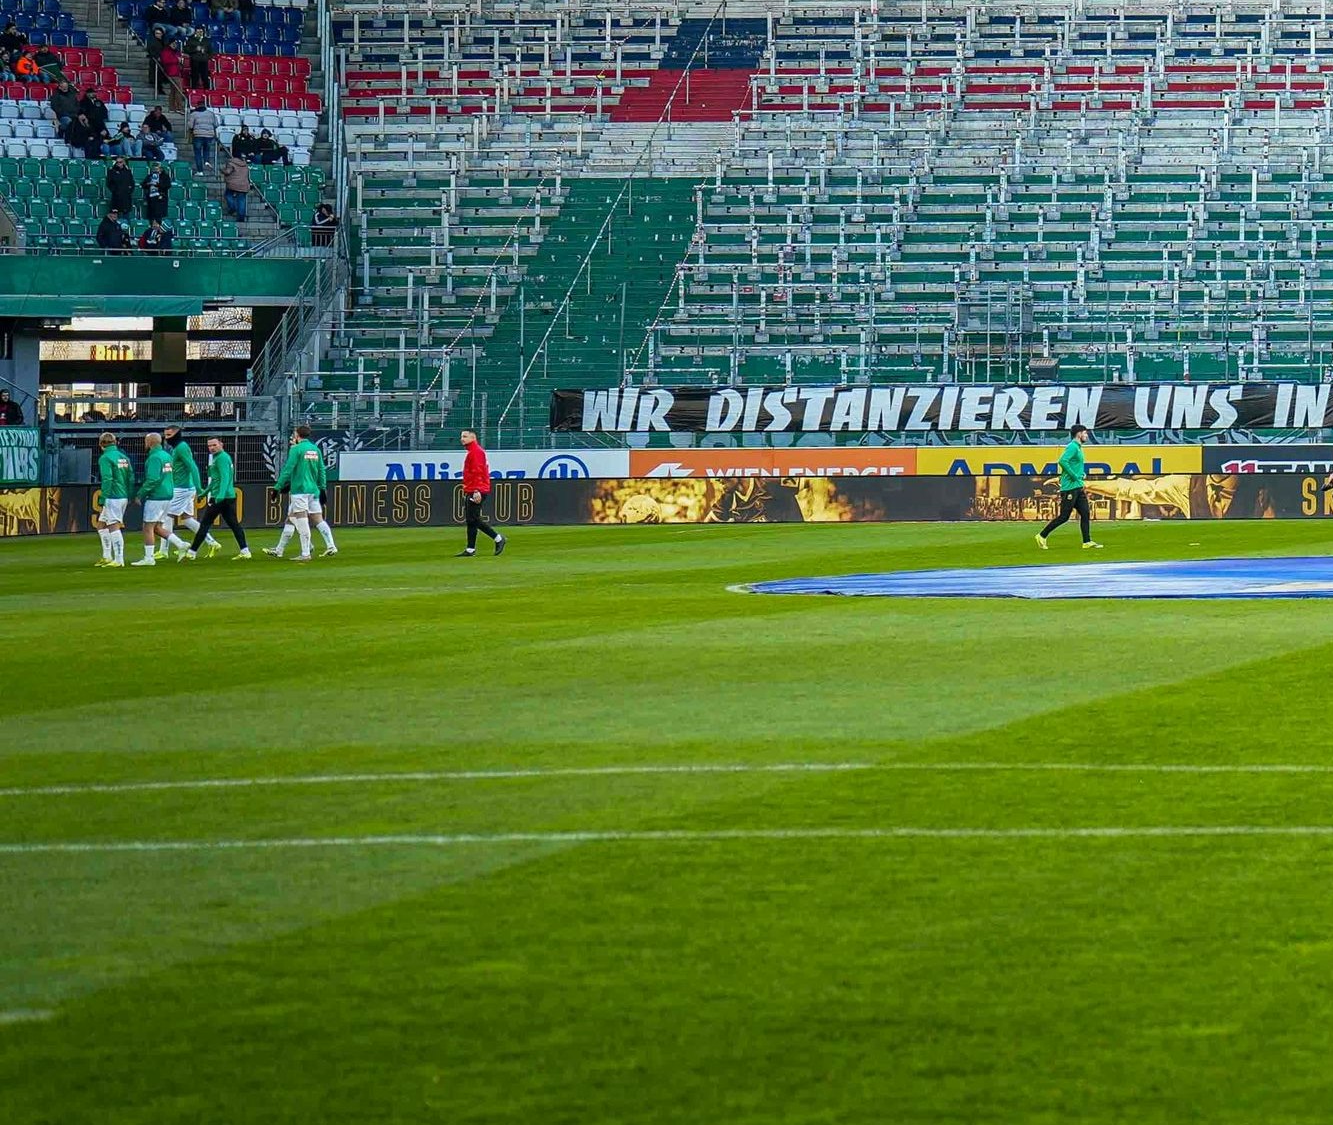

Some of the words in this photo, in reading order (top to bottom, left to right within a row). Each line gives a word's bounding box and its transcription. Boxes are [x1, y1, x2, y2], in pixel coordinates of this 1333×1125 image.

[582, 388, 675, 431] WIR
[705, 386, 1103, 431] DISTANZIEREN
[1135, 384, 1244, 428] UNS
[1273, 384, 1331, 428] IN
[452, 482, 534, 523] CUB
